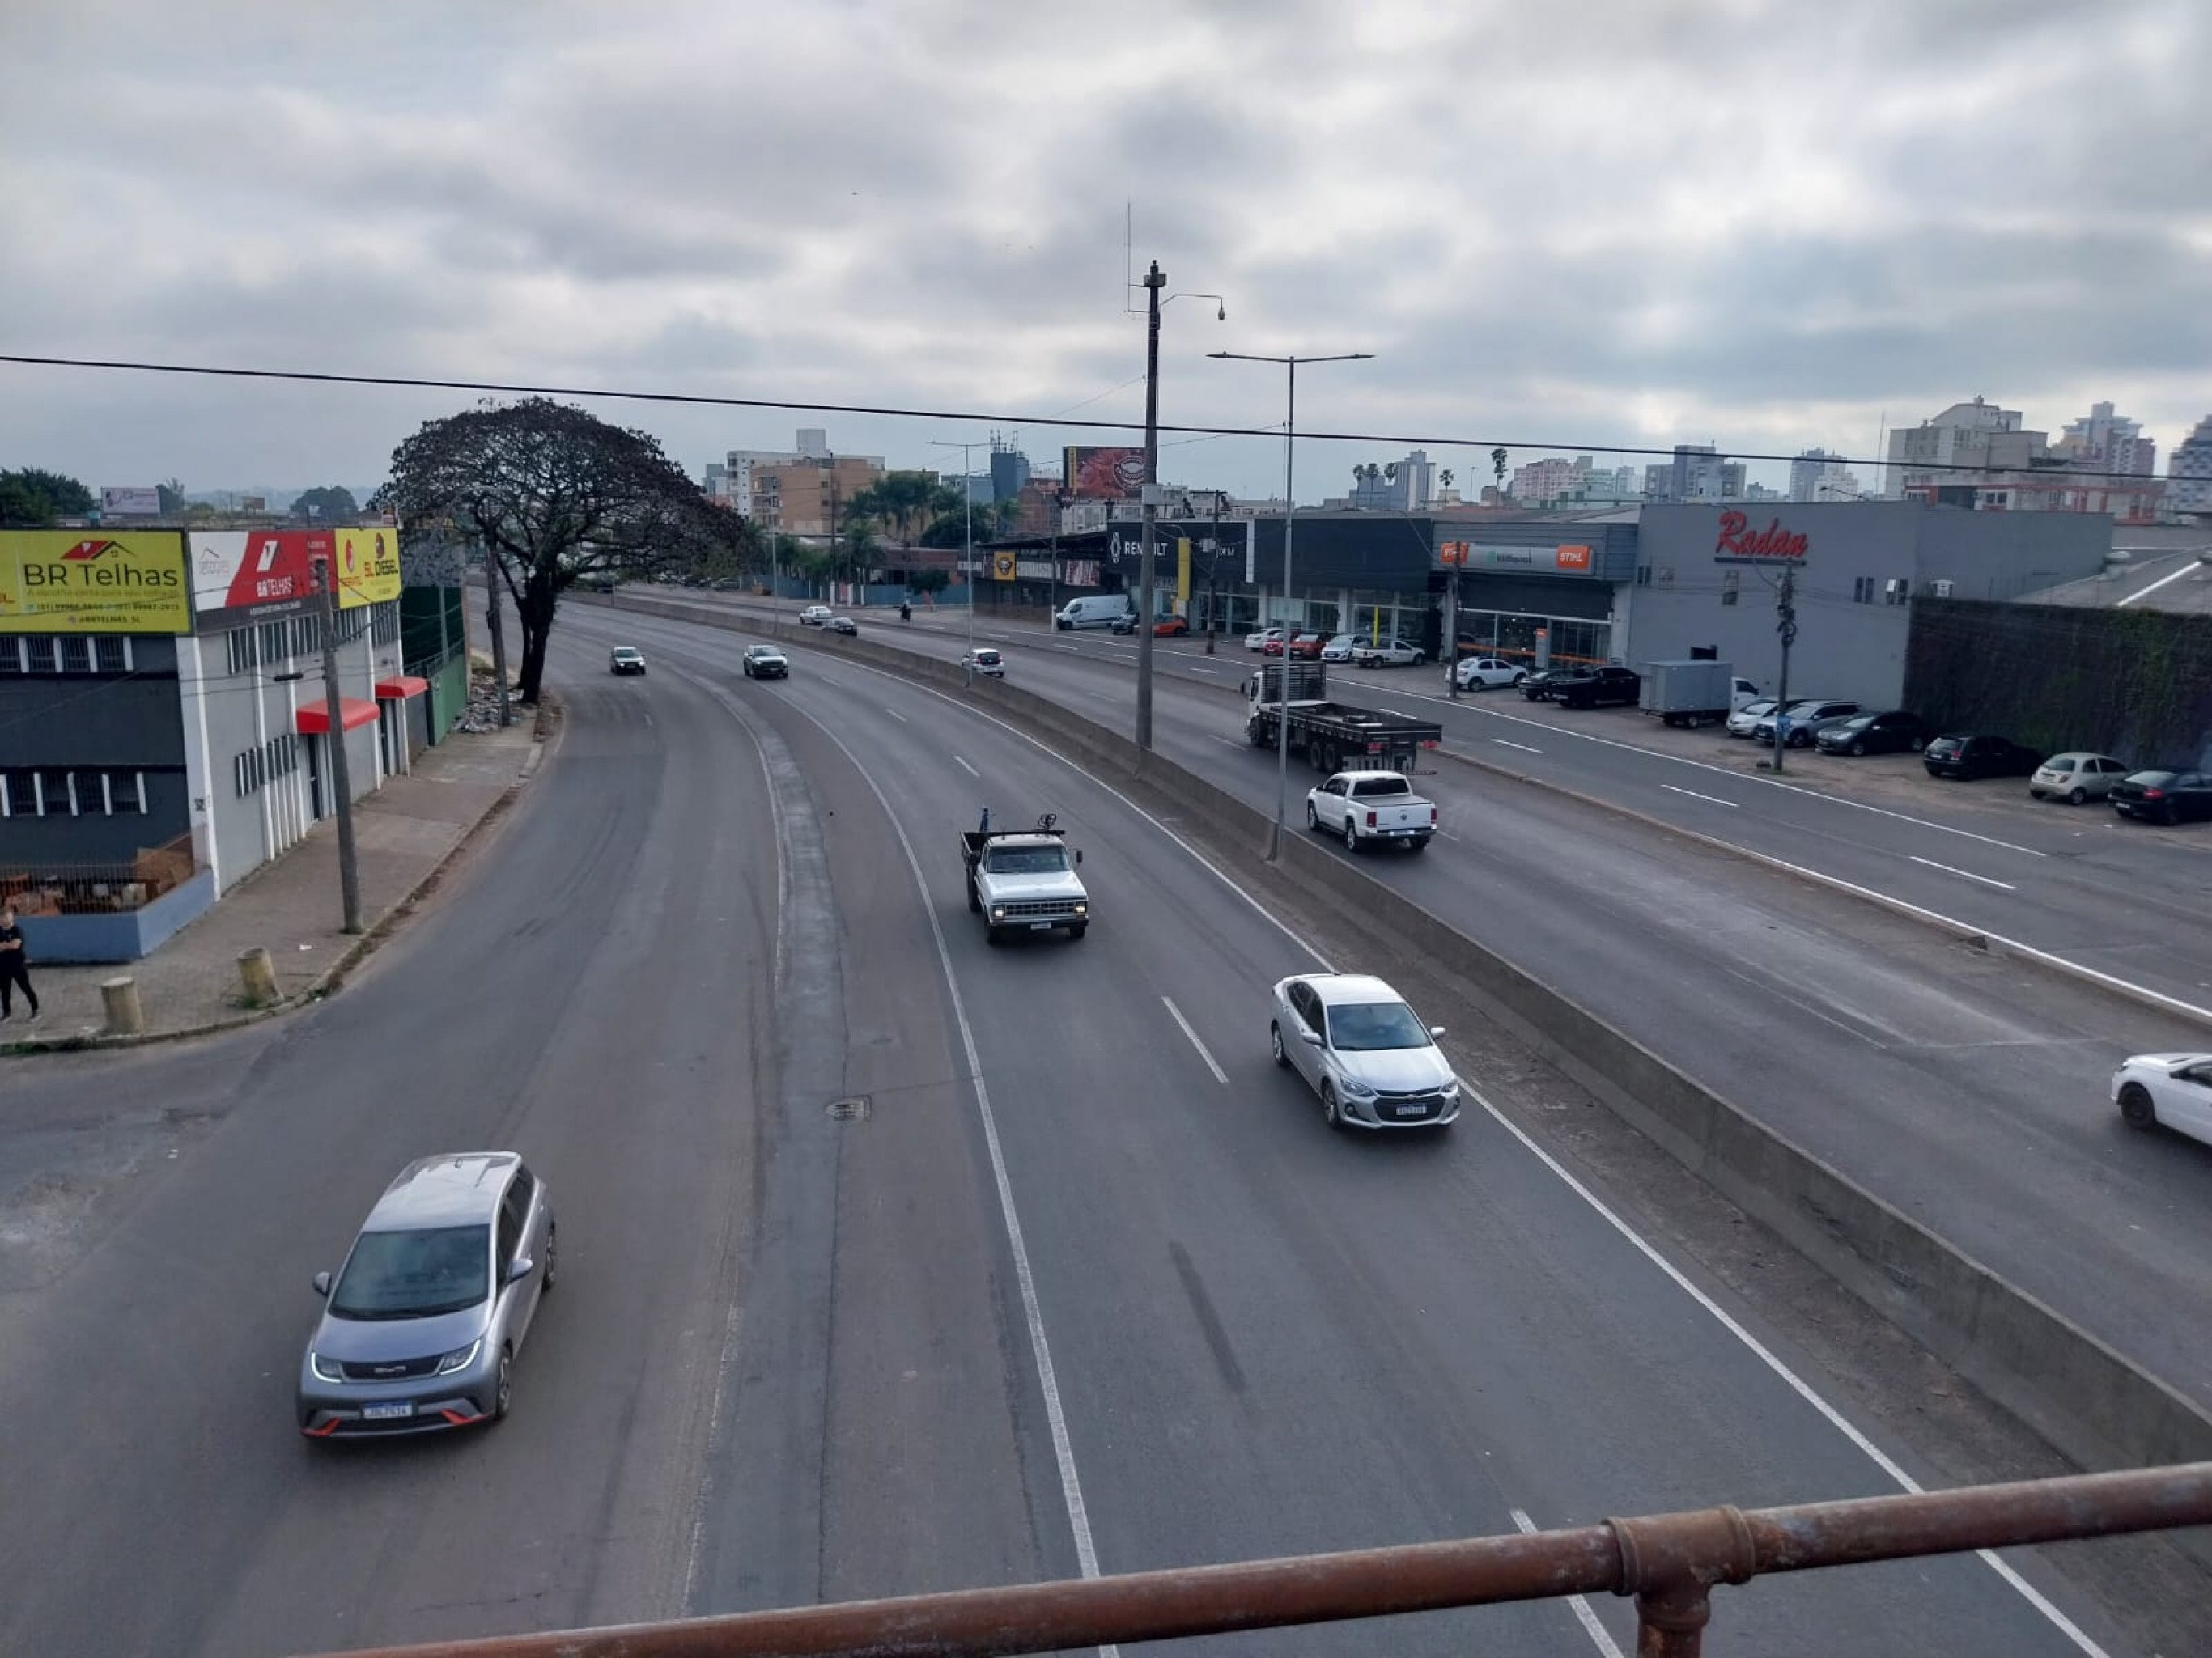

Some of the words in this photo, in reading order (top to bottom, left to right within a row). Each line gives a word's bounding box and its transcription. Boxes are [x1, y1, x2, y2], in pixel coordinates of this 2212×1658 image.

[1716, 511, 1808, 557] Radan
[23, 564, 68, 586] BR
[77, 564, 178, 587] Telhas
